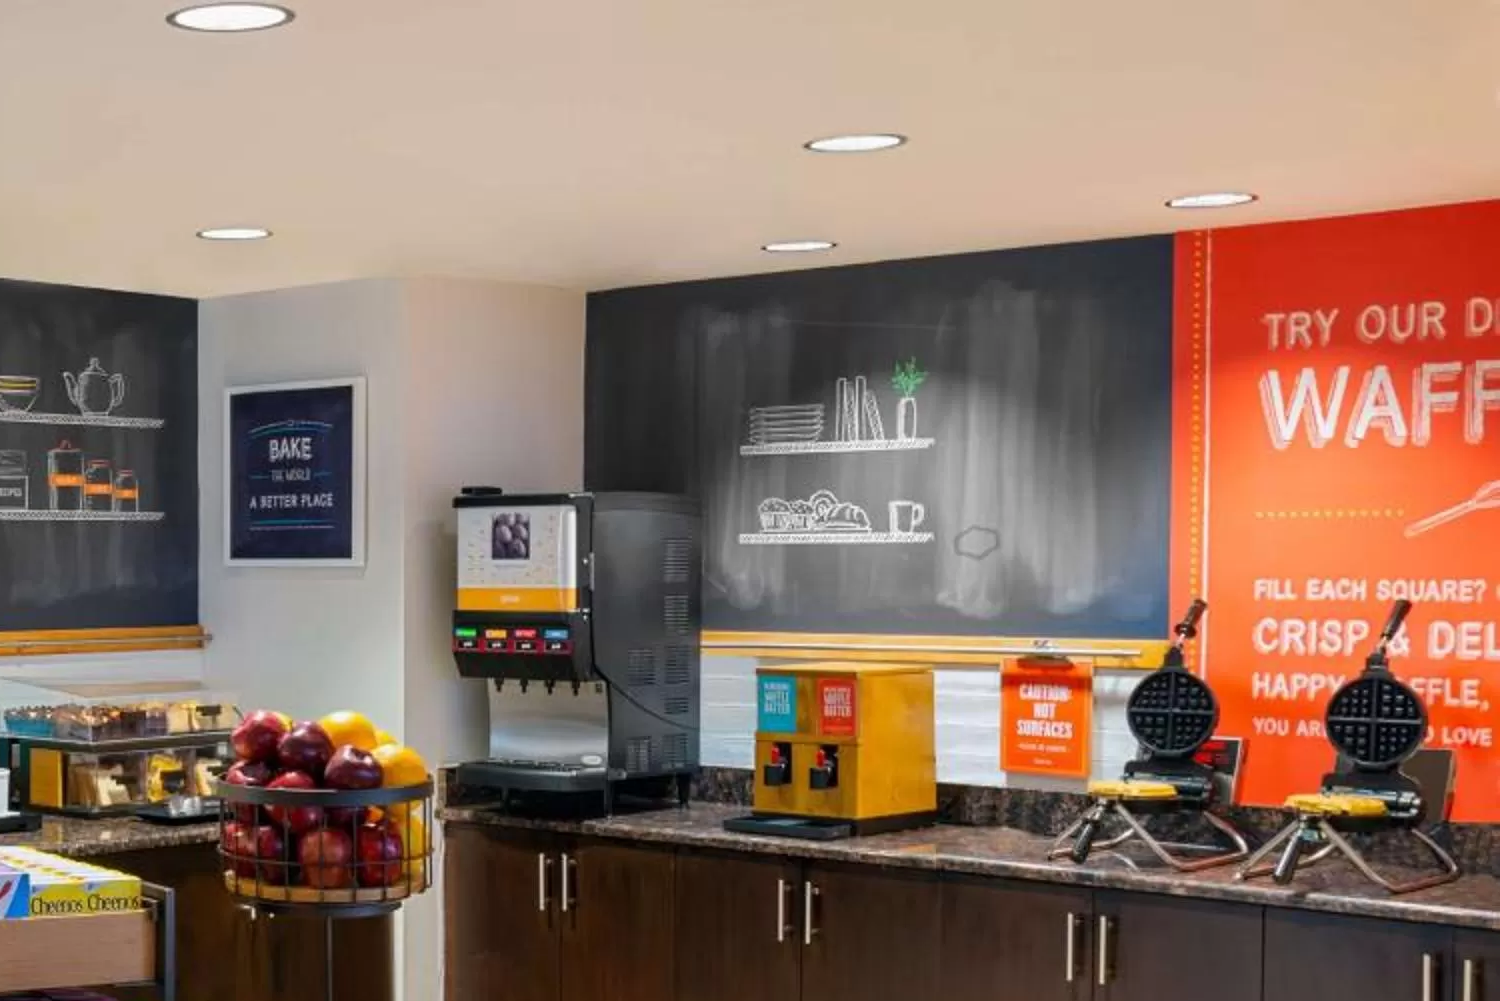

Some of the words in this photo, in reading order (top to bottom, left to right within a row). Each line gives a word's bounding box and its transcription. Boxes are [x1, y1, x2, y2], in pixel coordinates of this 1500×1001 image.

[1262, 308, 1339, 350] TRY
[1356, 301, 1447, 344] OUR
[269, 437, 313, 462] BAKE
[249, 496, 258, 509] A
[260, 494, 297, 509] BETTER
[300, 492, 334, 508] PLACE
[1253, 578, 1298, 600] FILL
[1306, 578, 1367, 601] EACH
[1376, 579, 1487, 602] SQUARE?
[1252, 616, 1370, 656] CRISP
[1251, 671, 1346, 701] HAPPY
[1396, 676, 1490, 712] FFLE,
[1016, 719, 1074, 739] SURFACES
[1253, 717, 1289, 736] YOU
[1441, 726, 1492, 747] LOVE
[31, 896, 83, 916] Cheerios
[87, 892, 139, 913] Cheerios
